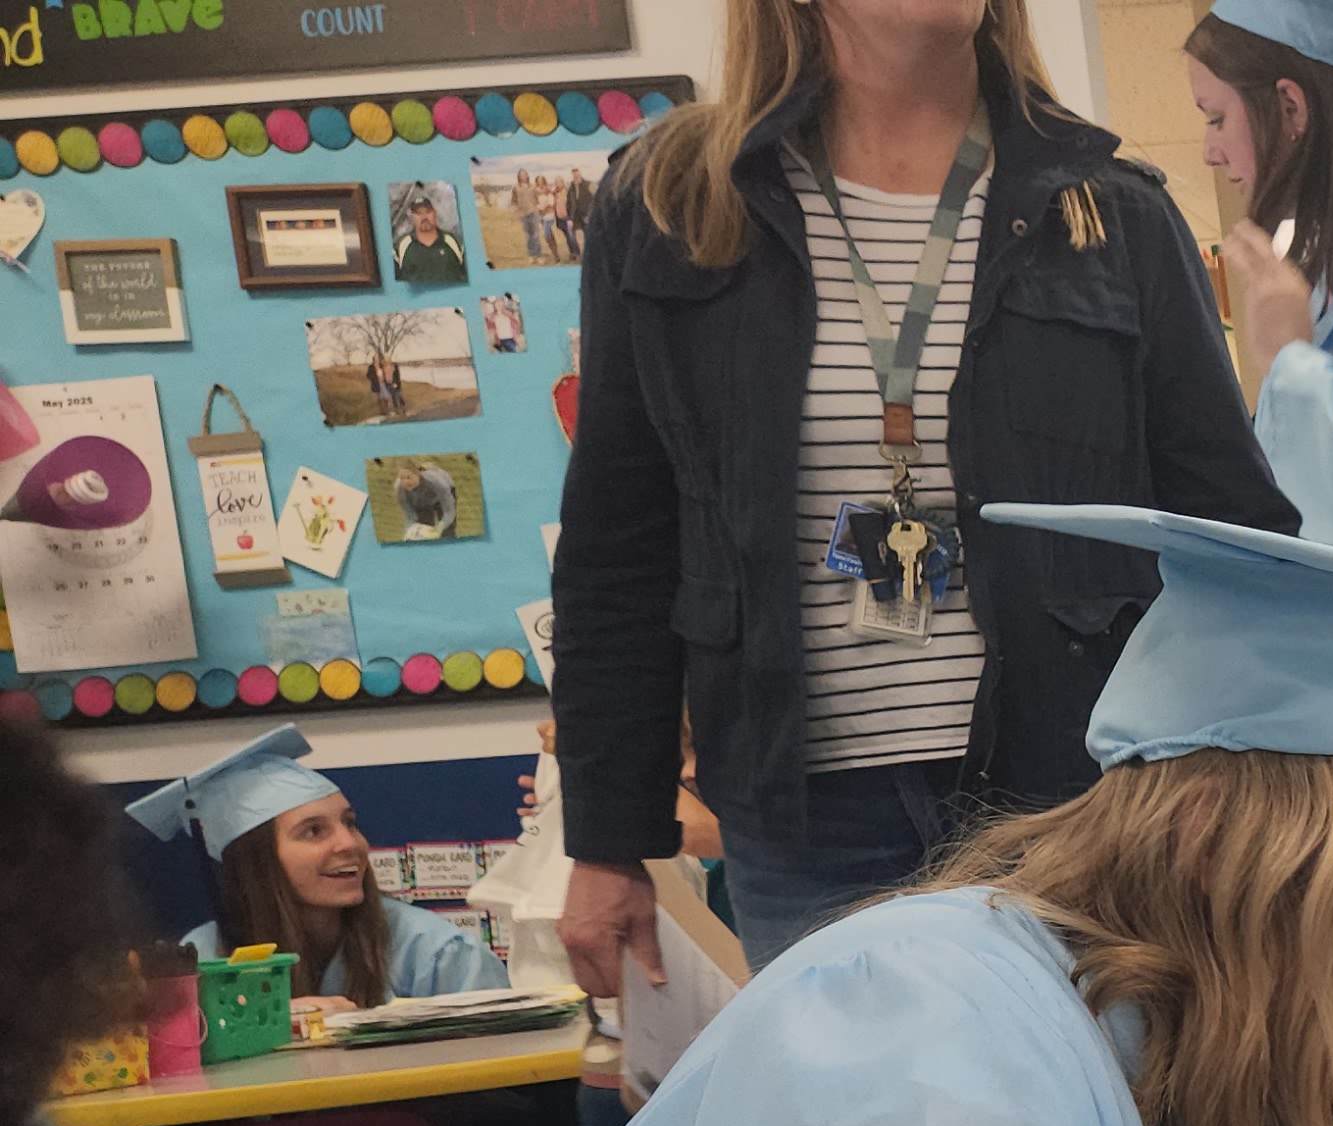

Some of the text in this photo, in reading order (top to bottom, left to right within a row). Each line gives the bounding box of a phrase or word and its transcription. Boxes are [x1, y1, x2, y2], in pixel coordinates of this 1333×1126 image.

[301, 4, 386, 37] COUNT
[42, 399, 63, 409] May
[208, 487, 264, 519] love
